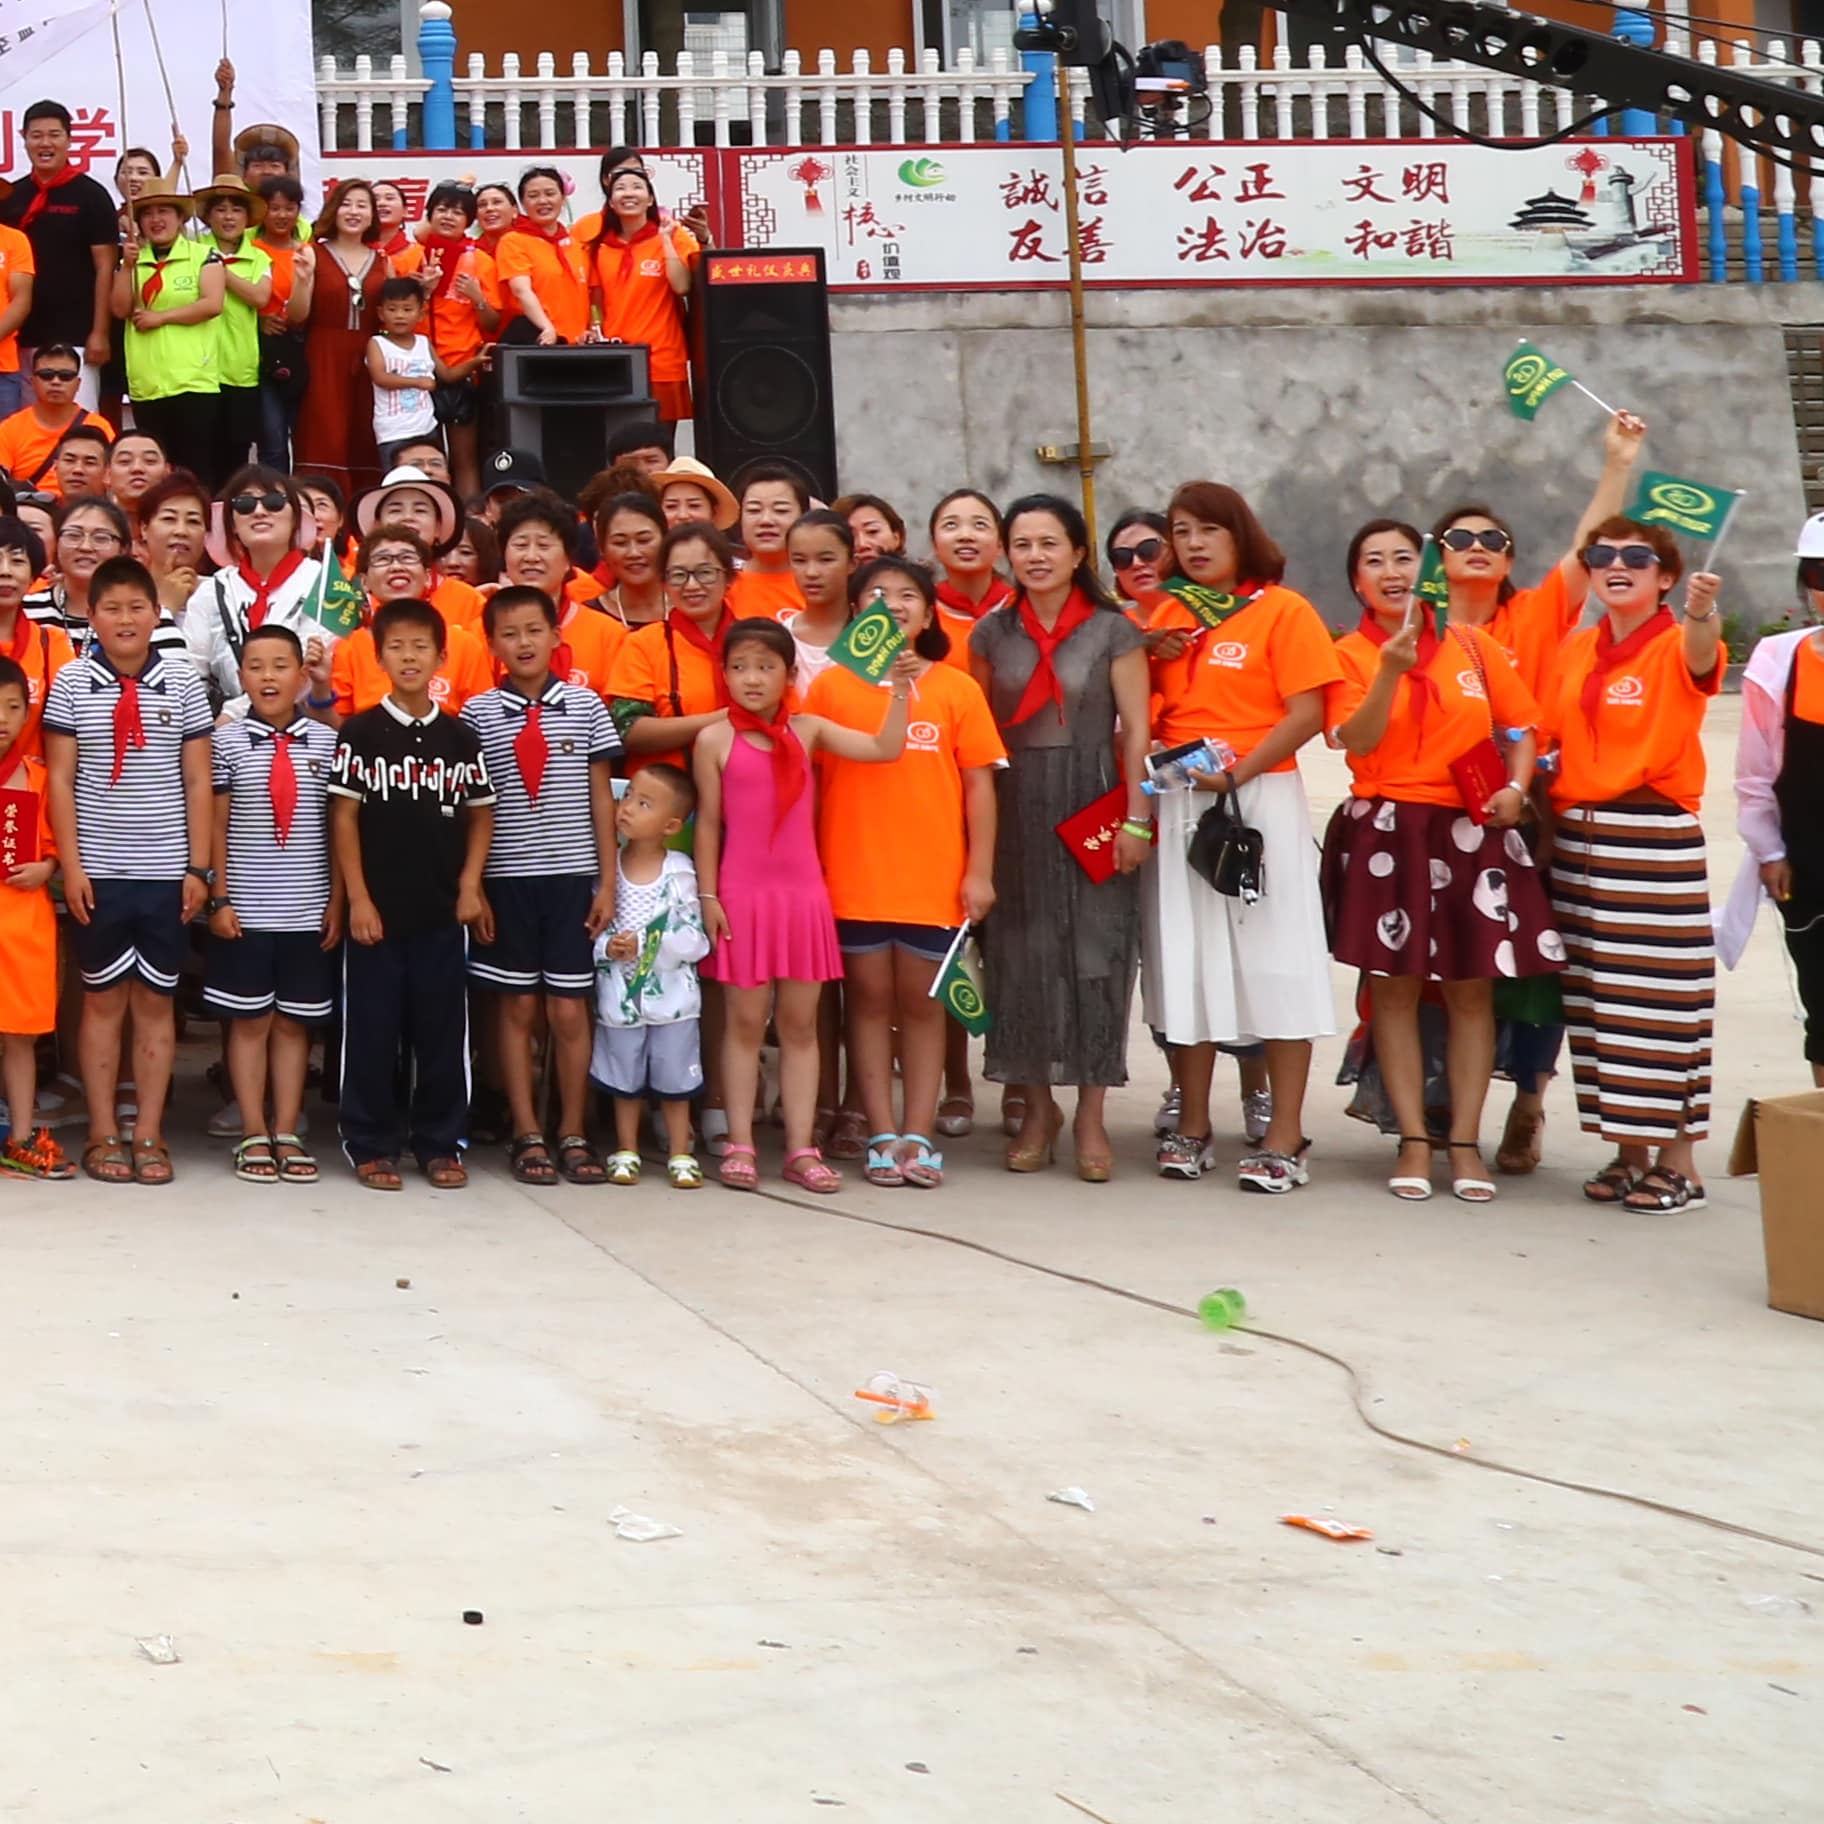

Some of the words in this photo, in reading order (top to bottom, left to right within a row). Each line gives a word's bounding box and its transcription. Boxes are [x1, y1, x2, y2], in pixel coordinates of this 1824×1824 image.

[1172, 162, 1287, 204] 公正
[1340, 162, 1451, 205] 文明
[1008, 217, 1116, 264] 友善
[1176, 215, 1287, 263] 法治
